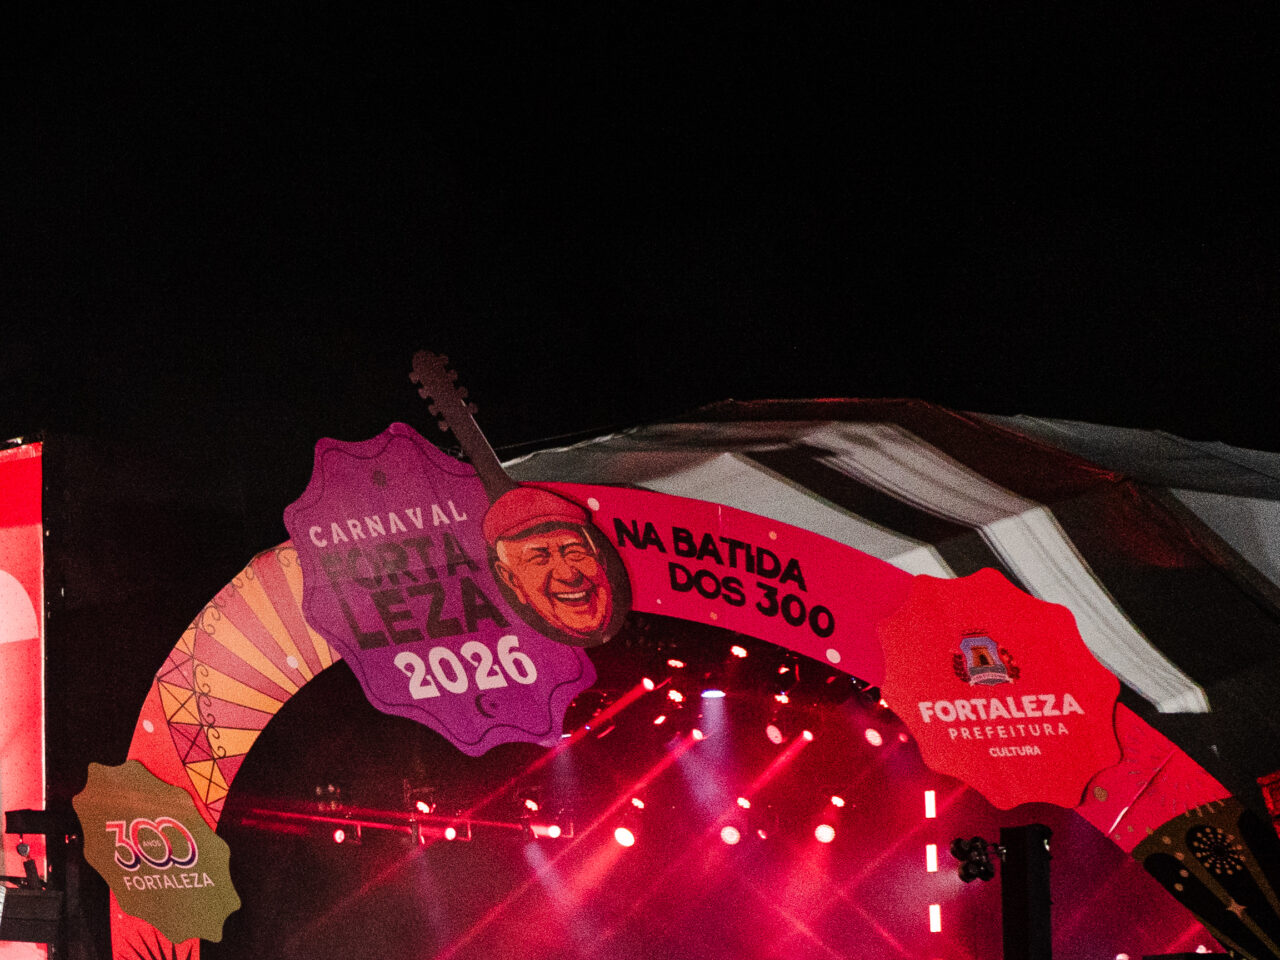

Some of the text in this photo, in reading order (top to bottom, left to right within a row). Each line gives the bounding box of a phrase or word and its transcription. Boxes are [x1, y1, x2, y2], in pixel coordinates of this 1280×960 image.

[309, 500, 468, 548] CARNAVAL
[320, 532, 480, 597] FORTA
[613, 517, 808, 593] NA BATIDA
[339, 576, 512, 650] LEZA
[668, 561, 836, 638] DOS 300
[393, 635, 538, 700] 2026
[918, 693, 1085, 723] FORTALEZA
[949, 722, 1069, 741] PREFEITURA
[989, 745, 1041, 758] CULTURA
[105, 816, 199, 872] 300
[123, 872, 215, 891] FORTALEZA
